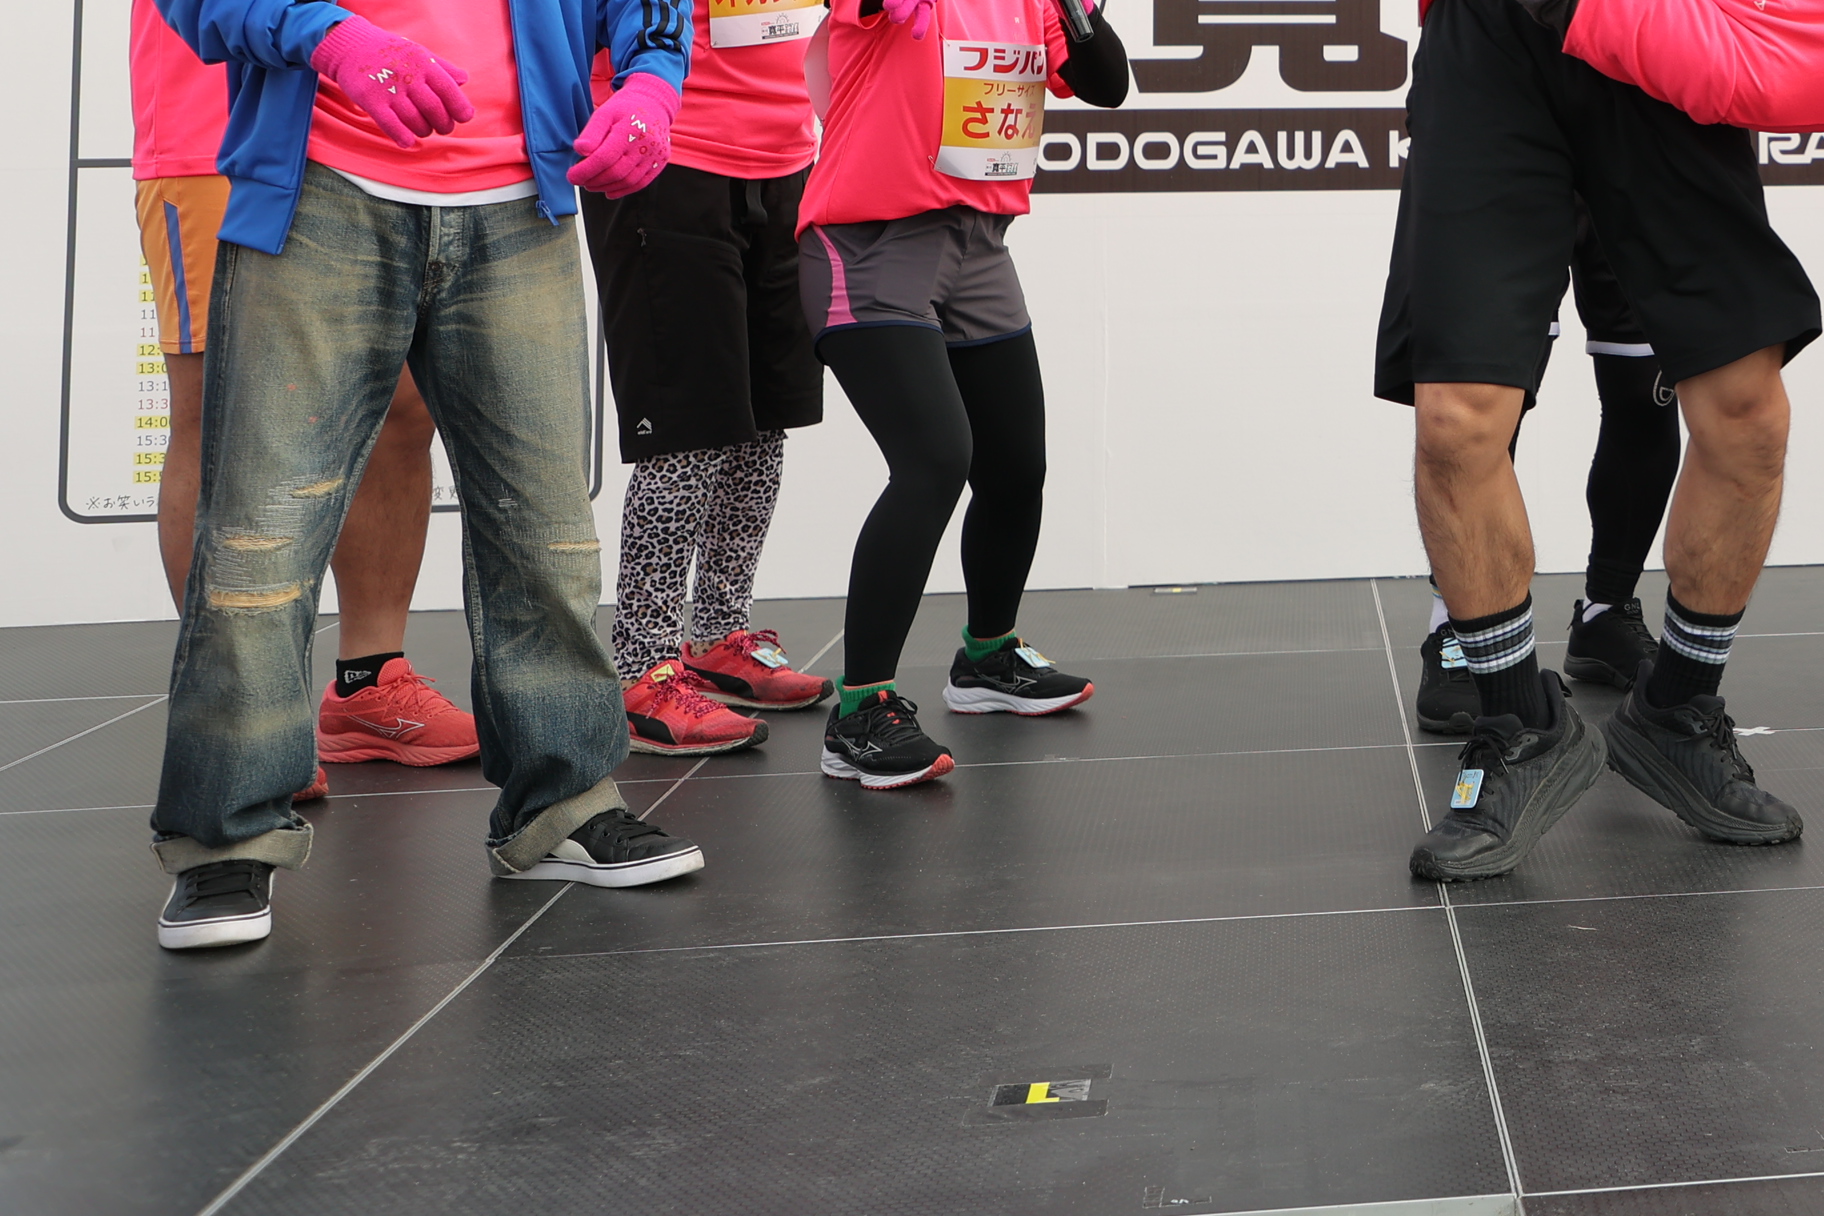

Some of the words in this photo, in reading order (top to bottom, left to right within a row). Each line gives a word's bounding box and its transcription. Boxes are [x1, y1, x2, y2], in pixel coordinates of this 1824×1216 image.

[959, 46, 1044, 75] フジパン
[984, 82, 1035, 97] フリーサイズ
[961, 100, 1037, 141] さなえ
[1037, 129, 1369, 171] ODOGAWA
[138, 381, 168, 392] 13:1
[137, 398, 169, 410] 13:3
[137, 417, 170, 428] 14:0
[136, 435, 170, 446] 15:3
